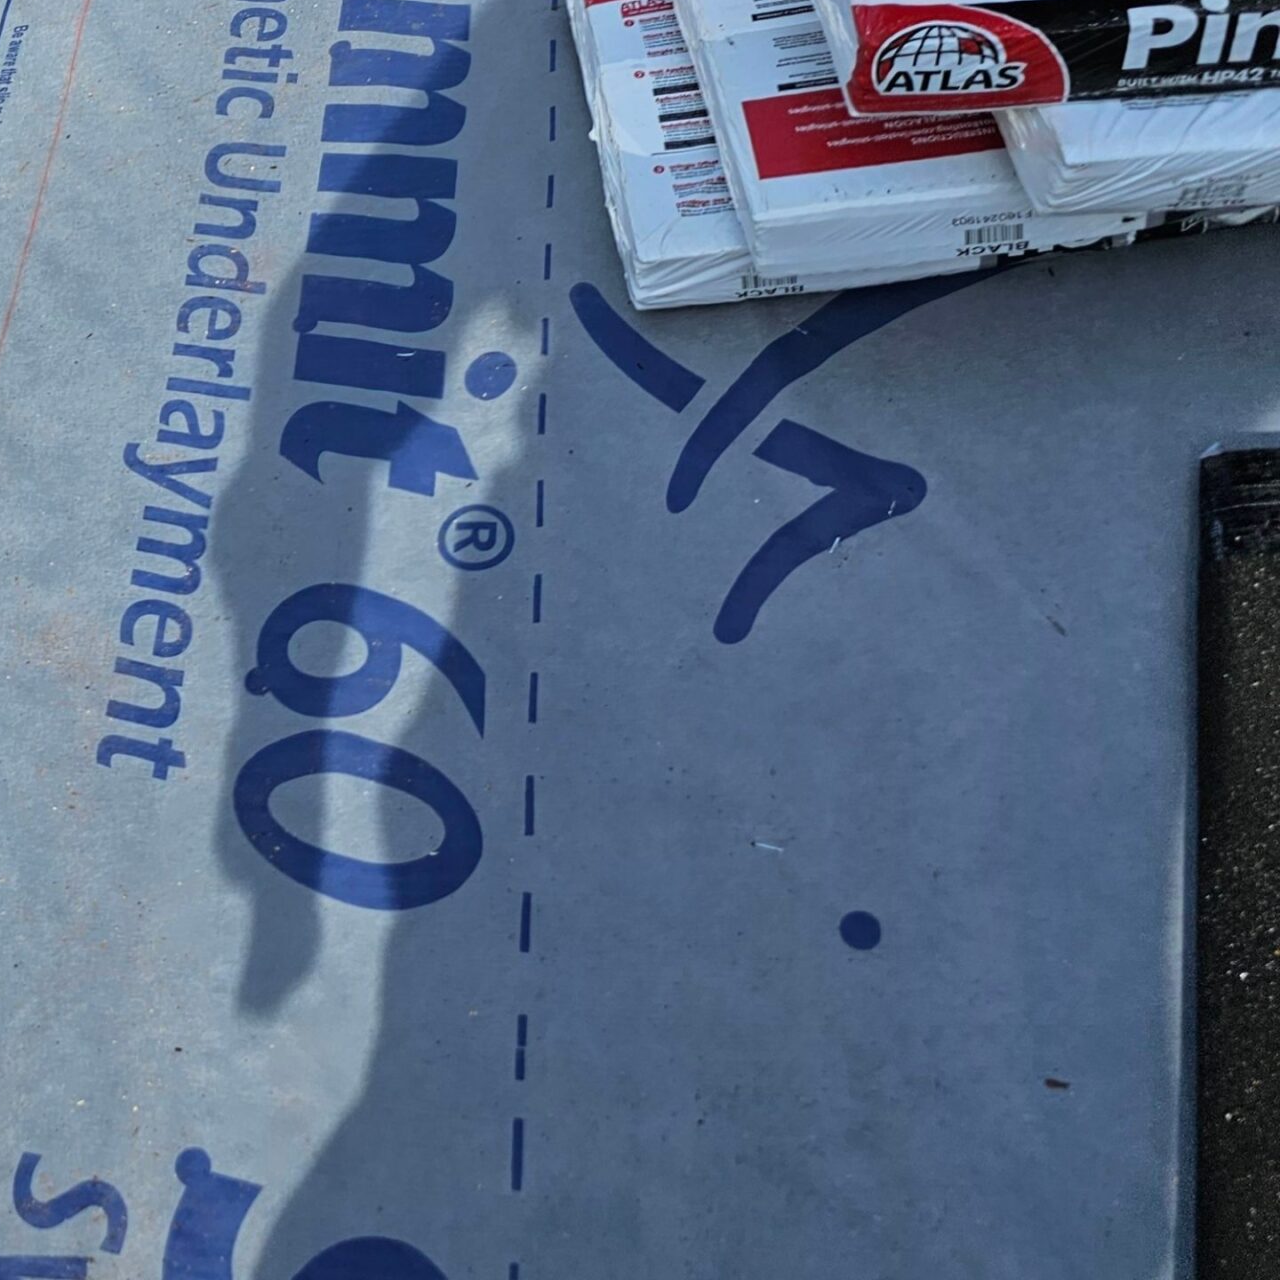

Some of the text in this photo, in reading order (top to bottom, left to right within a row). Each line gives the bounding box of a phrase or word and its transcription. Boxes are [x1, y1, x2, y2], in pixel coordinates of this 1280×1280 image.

[11, 23, 30, 39] Be
[2, 35, 23, 67] aware
[882, 65, 1024, 93] ATLAS
[1117, 76, 1156, 89] BUILT
[1199, 66, 1265, 86] HP42
[955, 239, 1030, 257] BLACK
[734, 283, 805, 298] BLACK
[96, 142, 282, 782] Underlayment
[233, 581, 487, 912] 60
